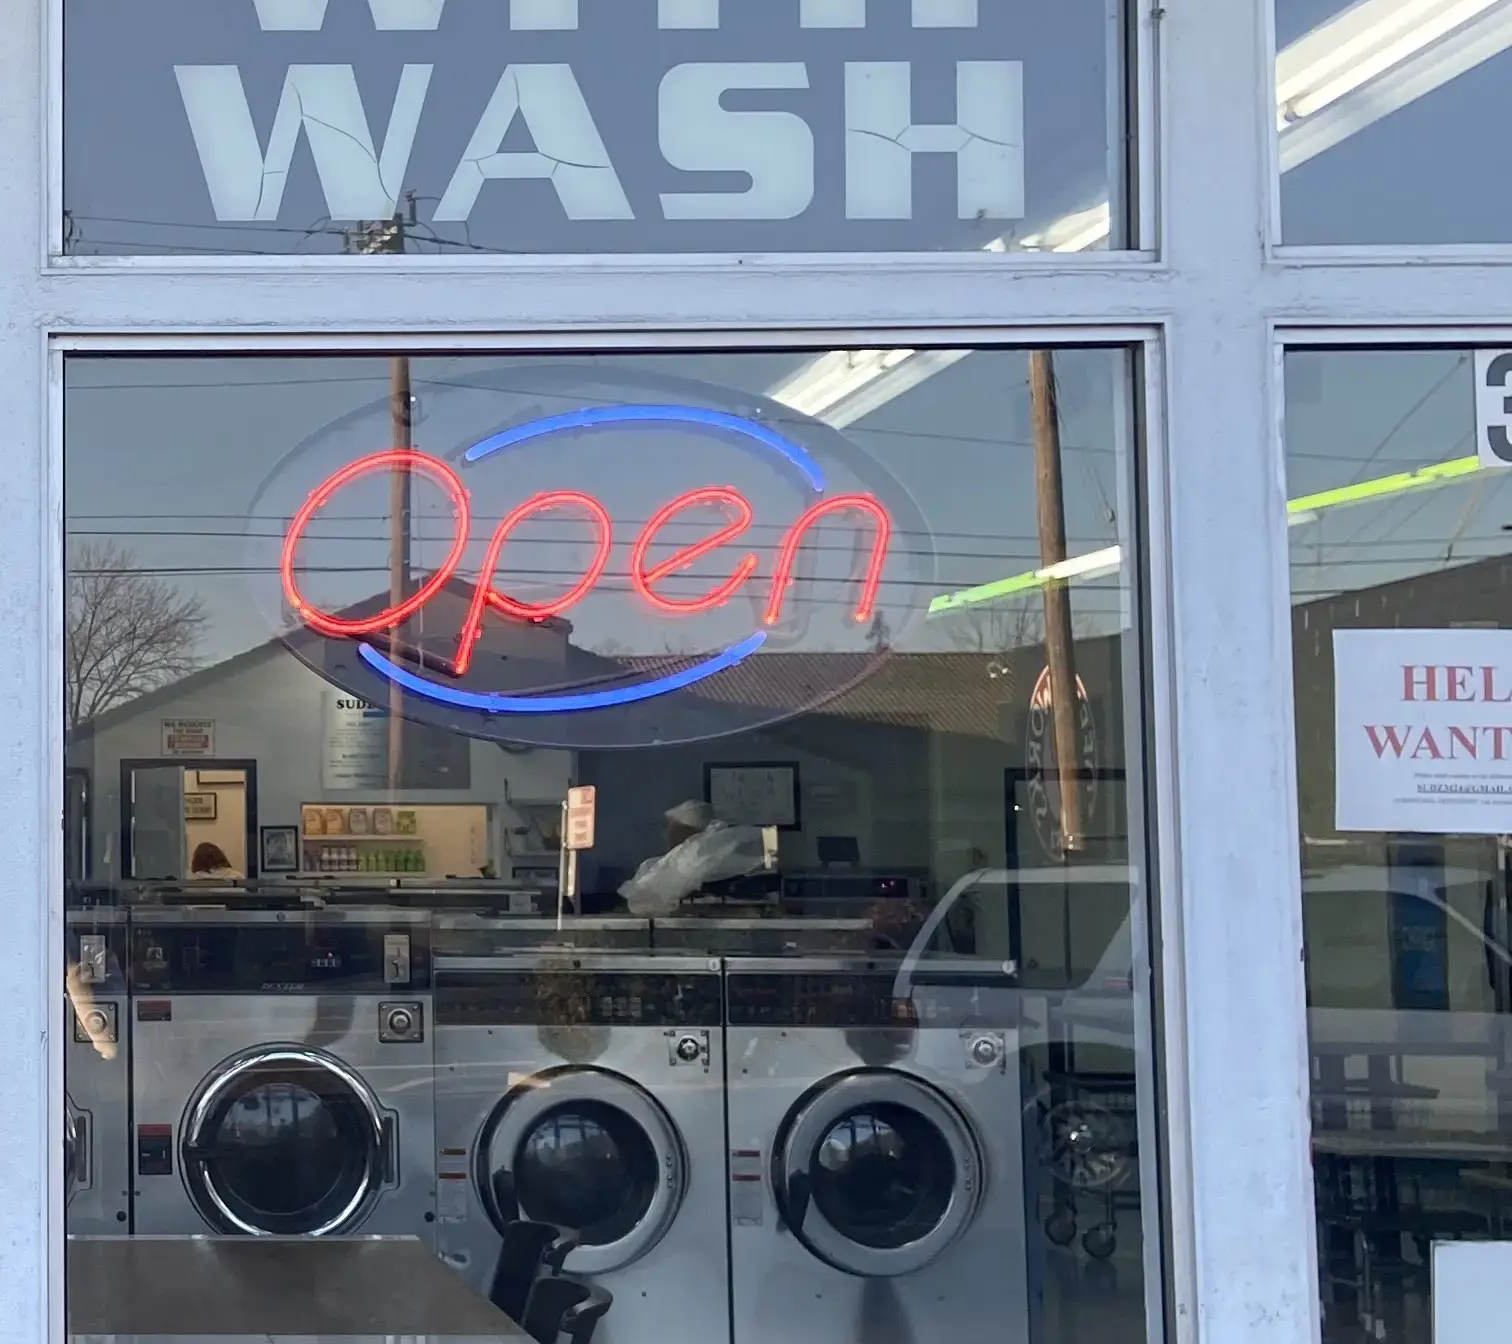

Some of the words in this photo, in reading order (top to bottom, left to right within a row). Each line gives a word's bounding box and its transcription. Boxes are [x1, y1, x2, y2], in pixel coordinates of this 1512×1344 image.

[173, 60, 1025, 222] WASH
[282, 448, 890, 676] Open
[1362, 724, 1512, 761] WANT
